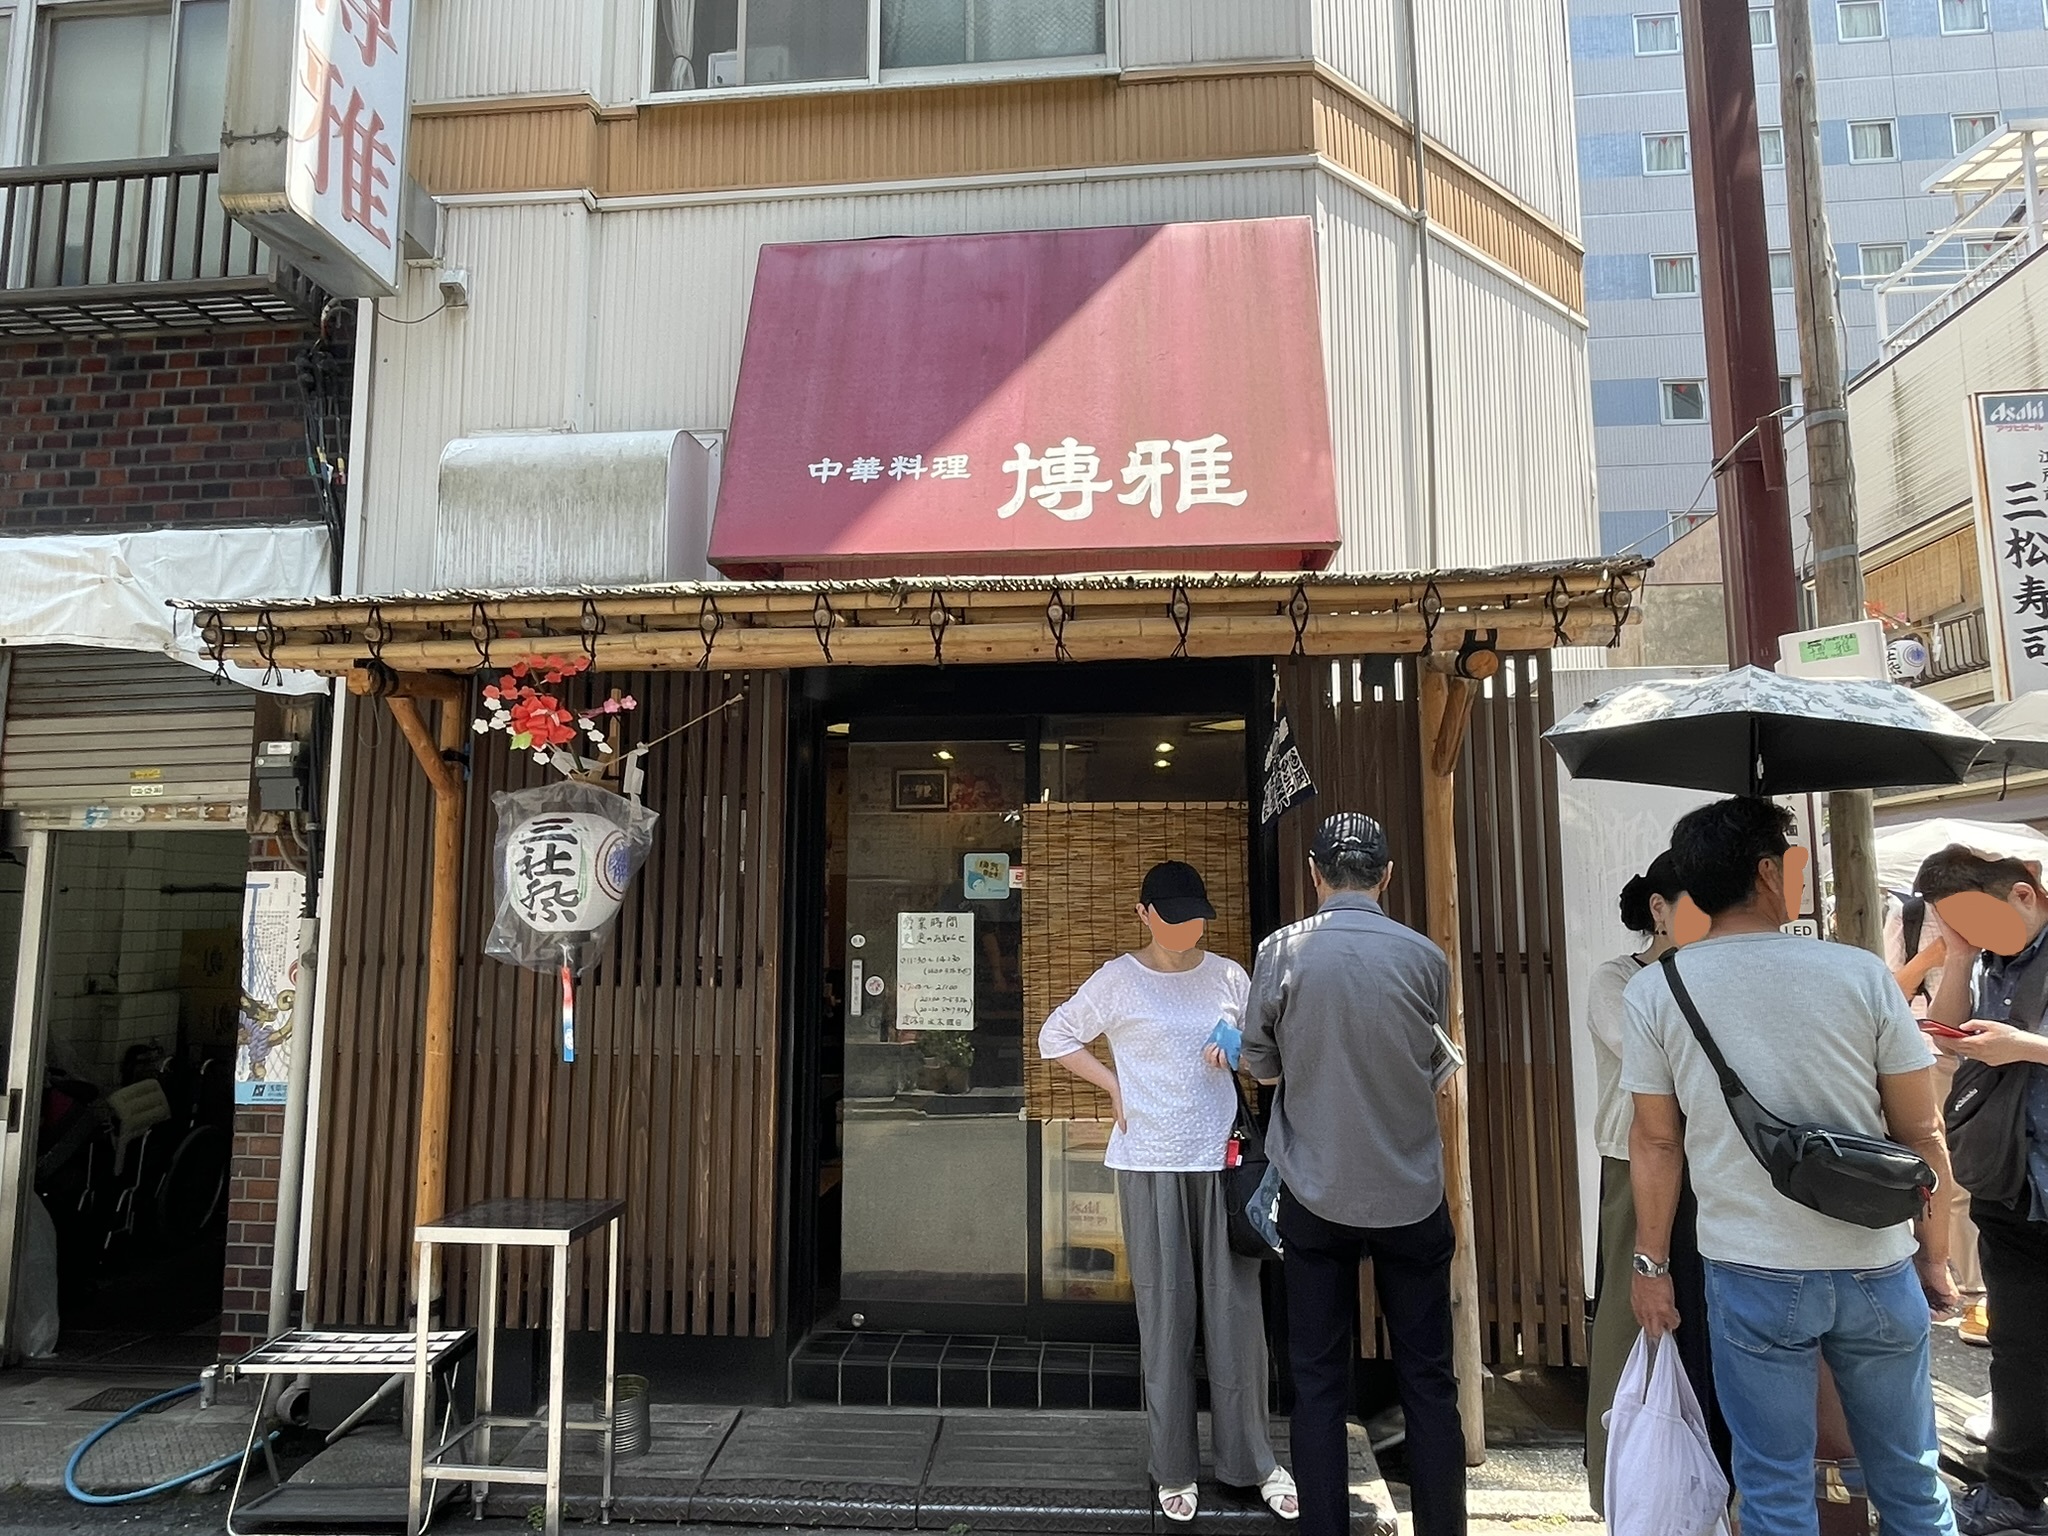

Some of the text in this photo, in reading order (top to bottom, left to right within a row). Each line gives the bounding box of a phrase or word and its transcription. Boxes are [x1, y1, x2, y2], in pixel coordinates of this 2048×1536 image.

[1990, 400, 2044, 422] Asahi
[1996, 424, 2044, 433] アサヒビール
[807, 433, 1249, 521] 中華料理 博雅
[2002, 481, 2048, 667] 三松寿司
[514, 817, 579, 923] 三社祭
